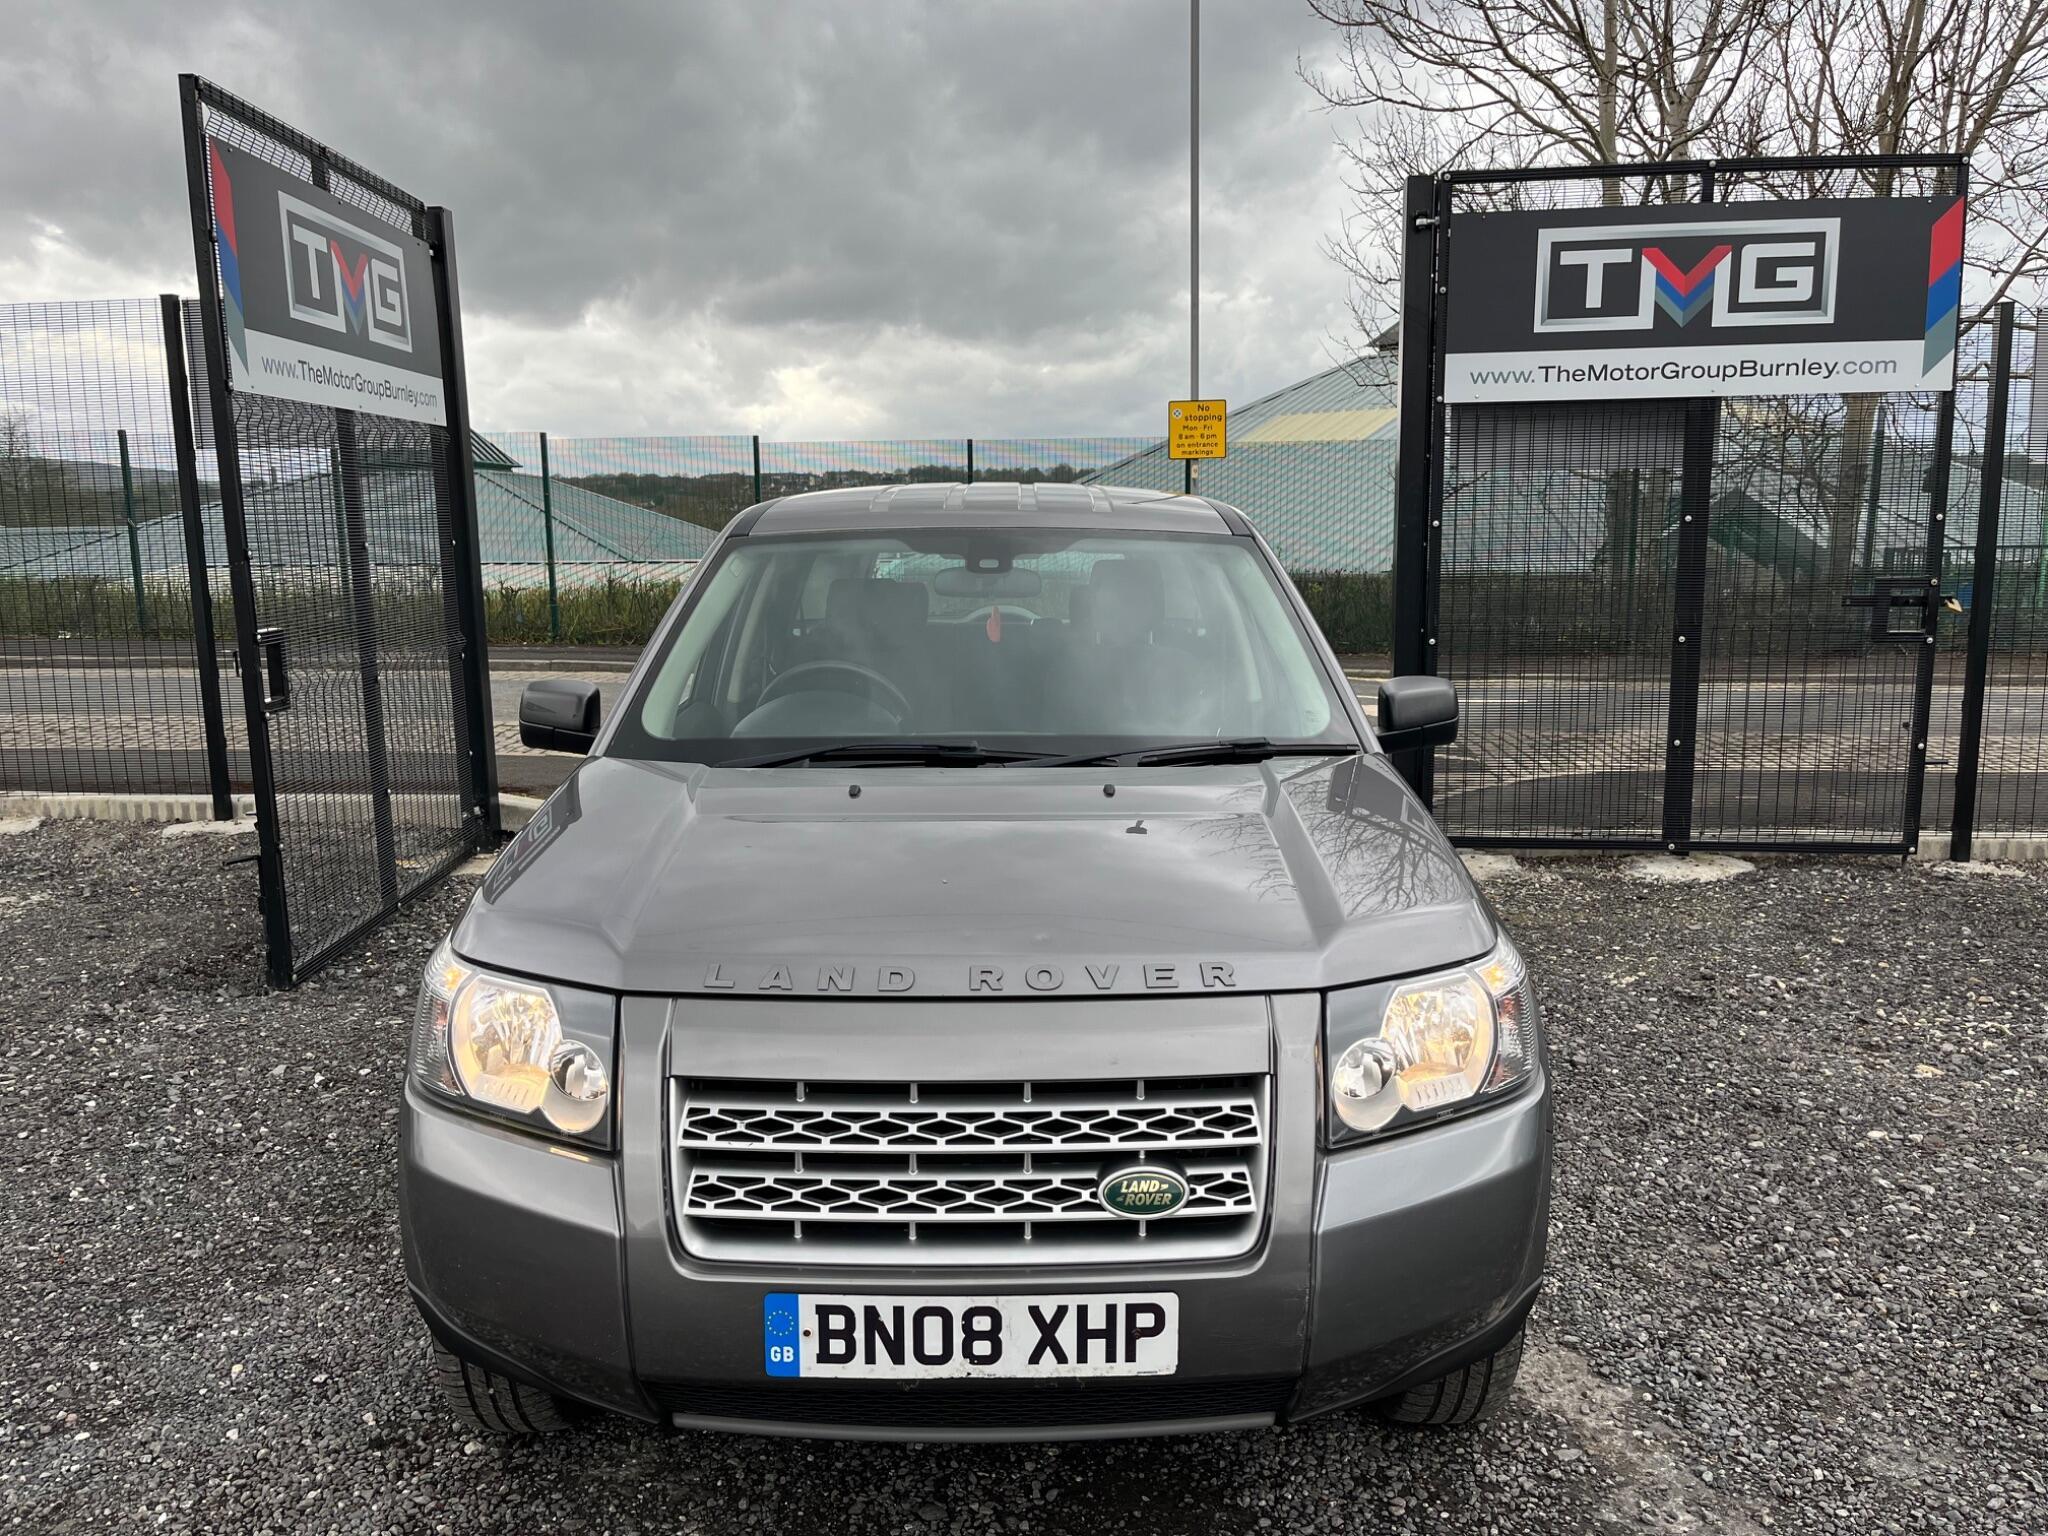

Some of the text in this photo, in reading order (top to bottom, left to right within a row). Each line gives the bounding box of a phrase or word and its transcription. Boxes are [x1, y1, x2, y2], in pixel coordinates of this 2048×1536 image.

[291, 223, 404, 336] TMG
[1559, 241, 1817, 328] TMG
[261, 355, 438, 408] www.TheMotorGroupBurnley.com
[1469, 355, 1898, 386] www.TheMotorGroupBurnley.com
[1184, 414, 1223, 422] stopping
[1197, 404, 1210, 412] No
[703, 961, 1238, 993] LAND ROVER
[1121, 1180, 1160, 1193] LAND
[1124, 1193, 1173, 1206] ROVER
[815, 1302, 1167, 1366] BN08 XHP
[770, 1346, 795, 1363] GB
